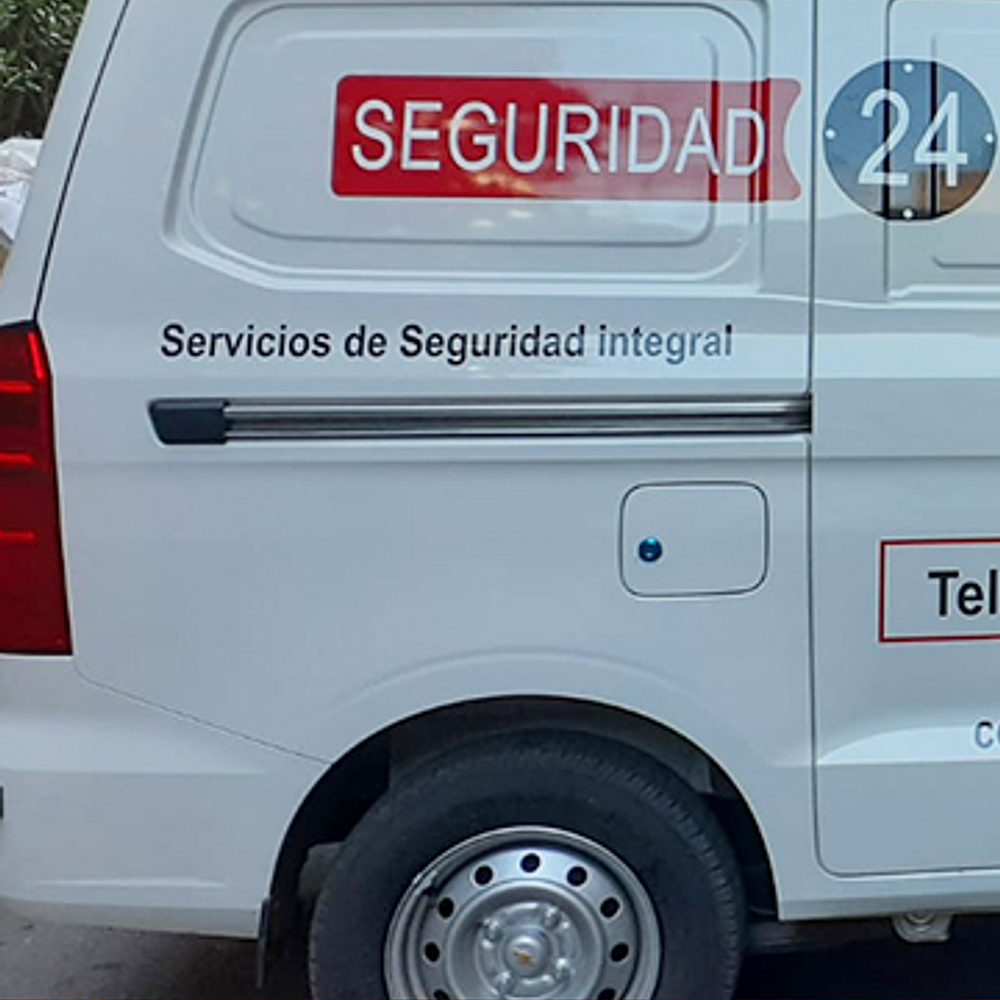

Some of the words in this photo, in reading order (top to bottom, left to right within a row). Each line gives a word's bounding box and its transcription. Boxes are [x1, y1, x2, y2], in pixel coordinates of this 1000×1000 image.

[350, 98, 766, 178] SEGURIDAD
[857, 88, 968, 188] 24
[160, 323, 332, 357] Servicios
[346, 323, 387, 357] de
[399, 323, 586, 365] Seguridad
[598, 323, 734, 365] integral
